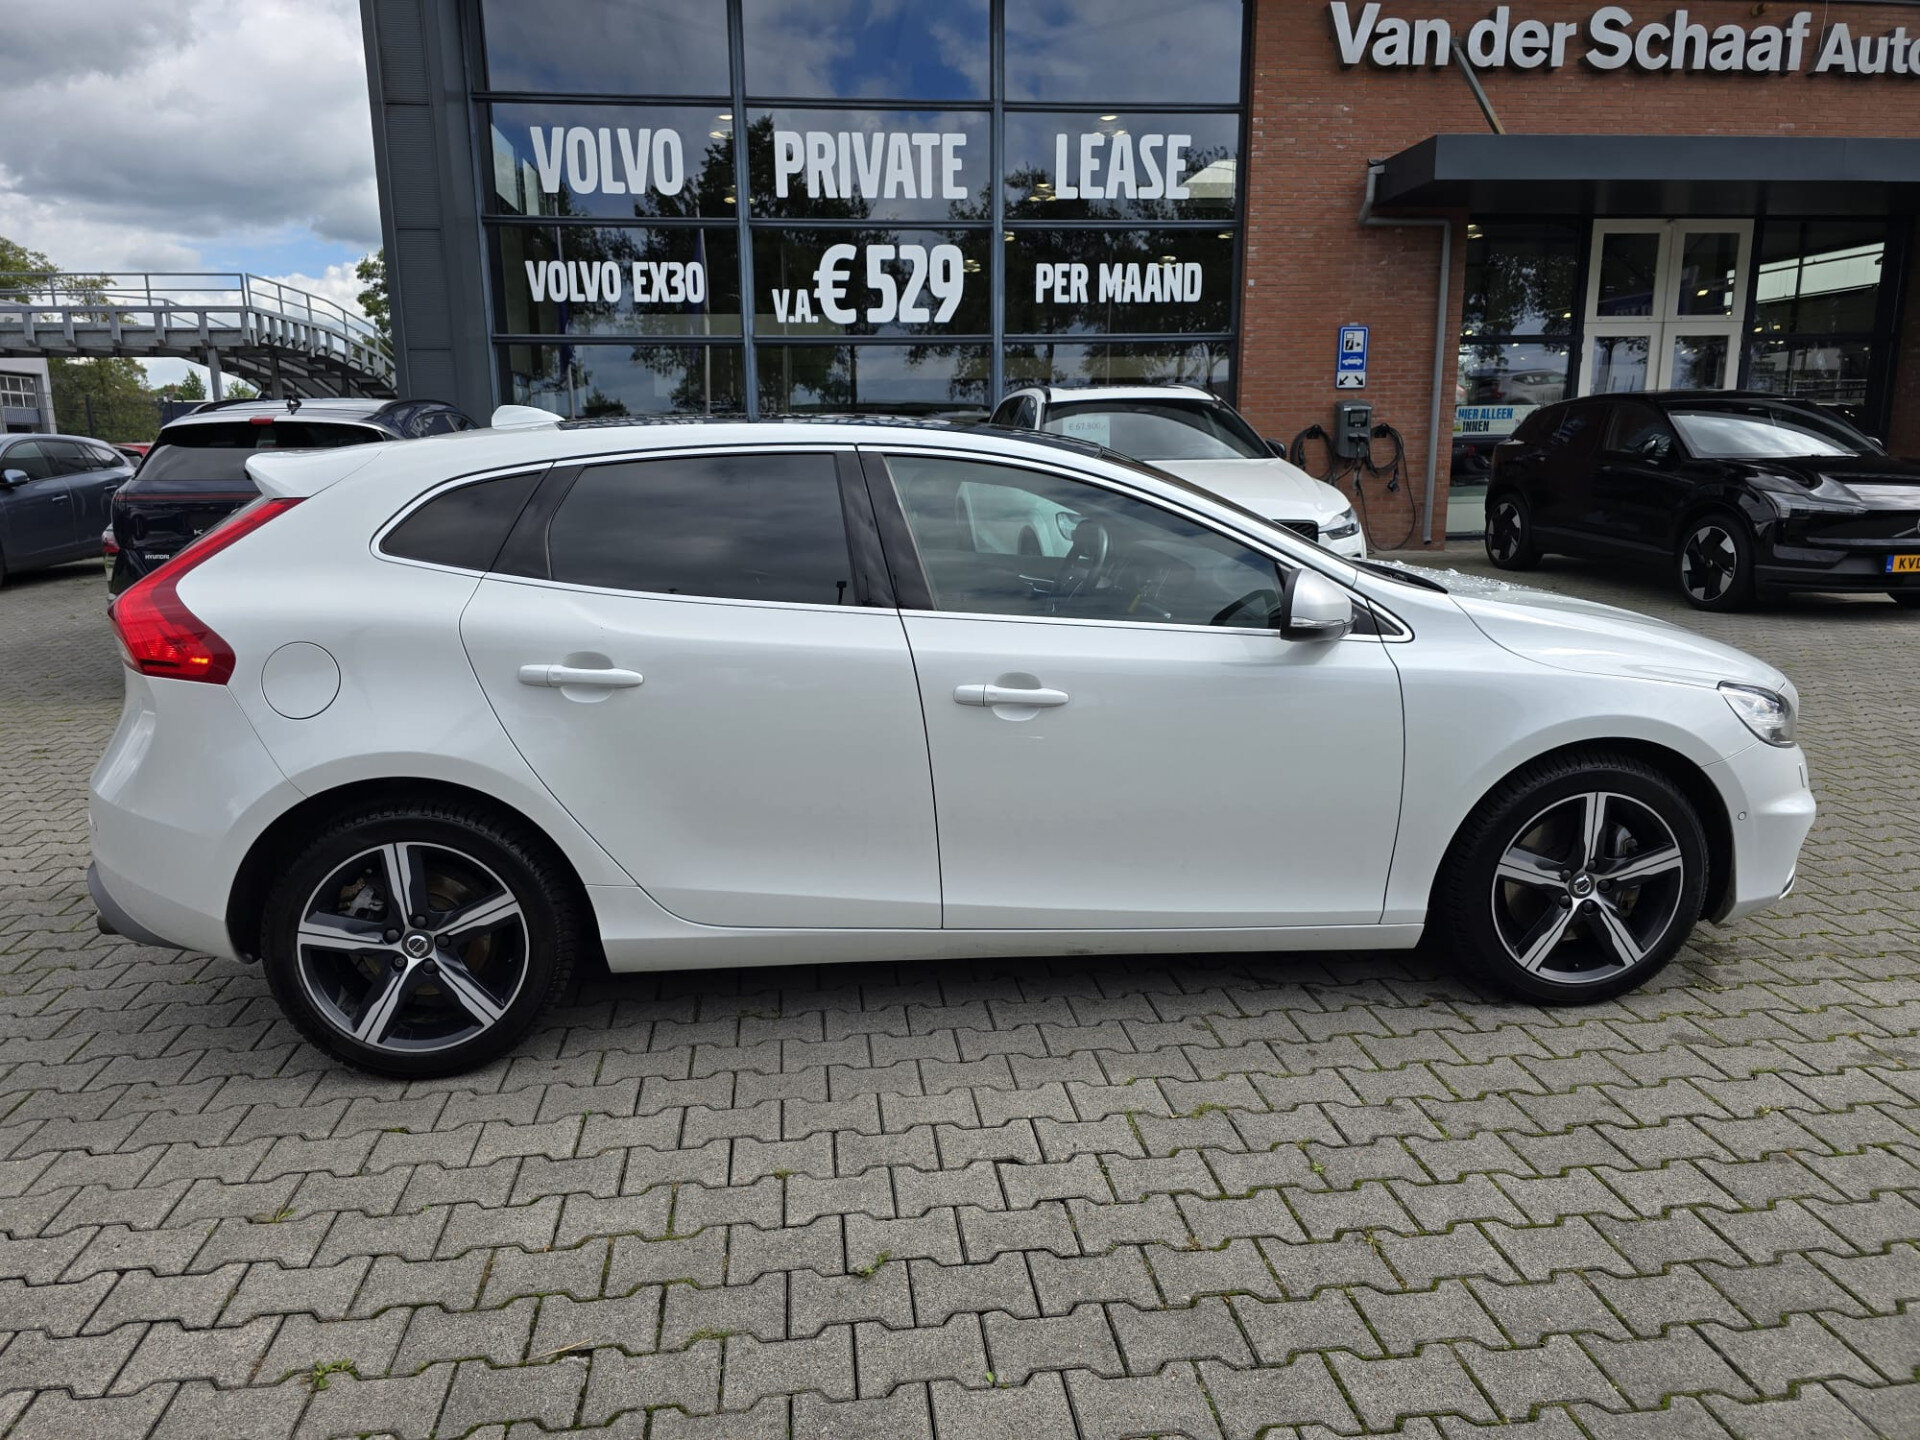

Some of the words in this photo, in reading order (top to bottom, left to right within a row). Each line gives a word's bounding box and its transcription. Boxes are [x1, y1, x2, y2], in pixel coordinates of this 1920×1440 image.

[1330, 1, 1451, 67] Van
[1467, 6, 1577, 68] der
[1585, 6, 1812, 71] Schaaf
[530, 126, 684, 196] VOLVO
[774, 131, 968, 199] PRIVATE
[1055, 133, 1192, 200] LEASE
[525, 260, 622, 303] VOLVO
[632, 261, 705, 303] EX30
[772, 288, 819, 323] V.A.
[1036, 262, 1089, 304] PER
[1099, 262, 1203, 303] MAAND
[1480, 408, 1513, 420] ALLEEN
